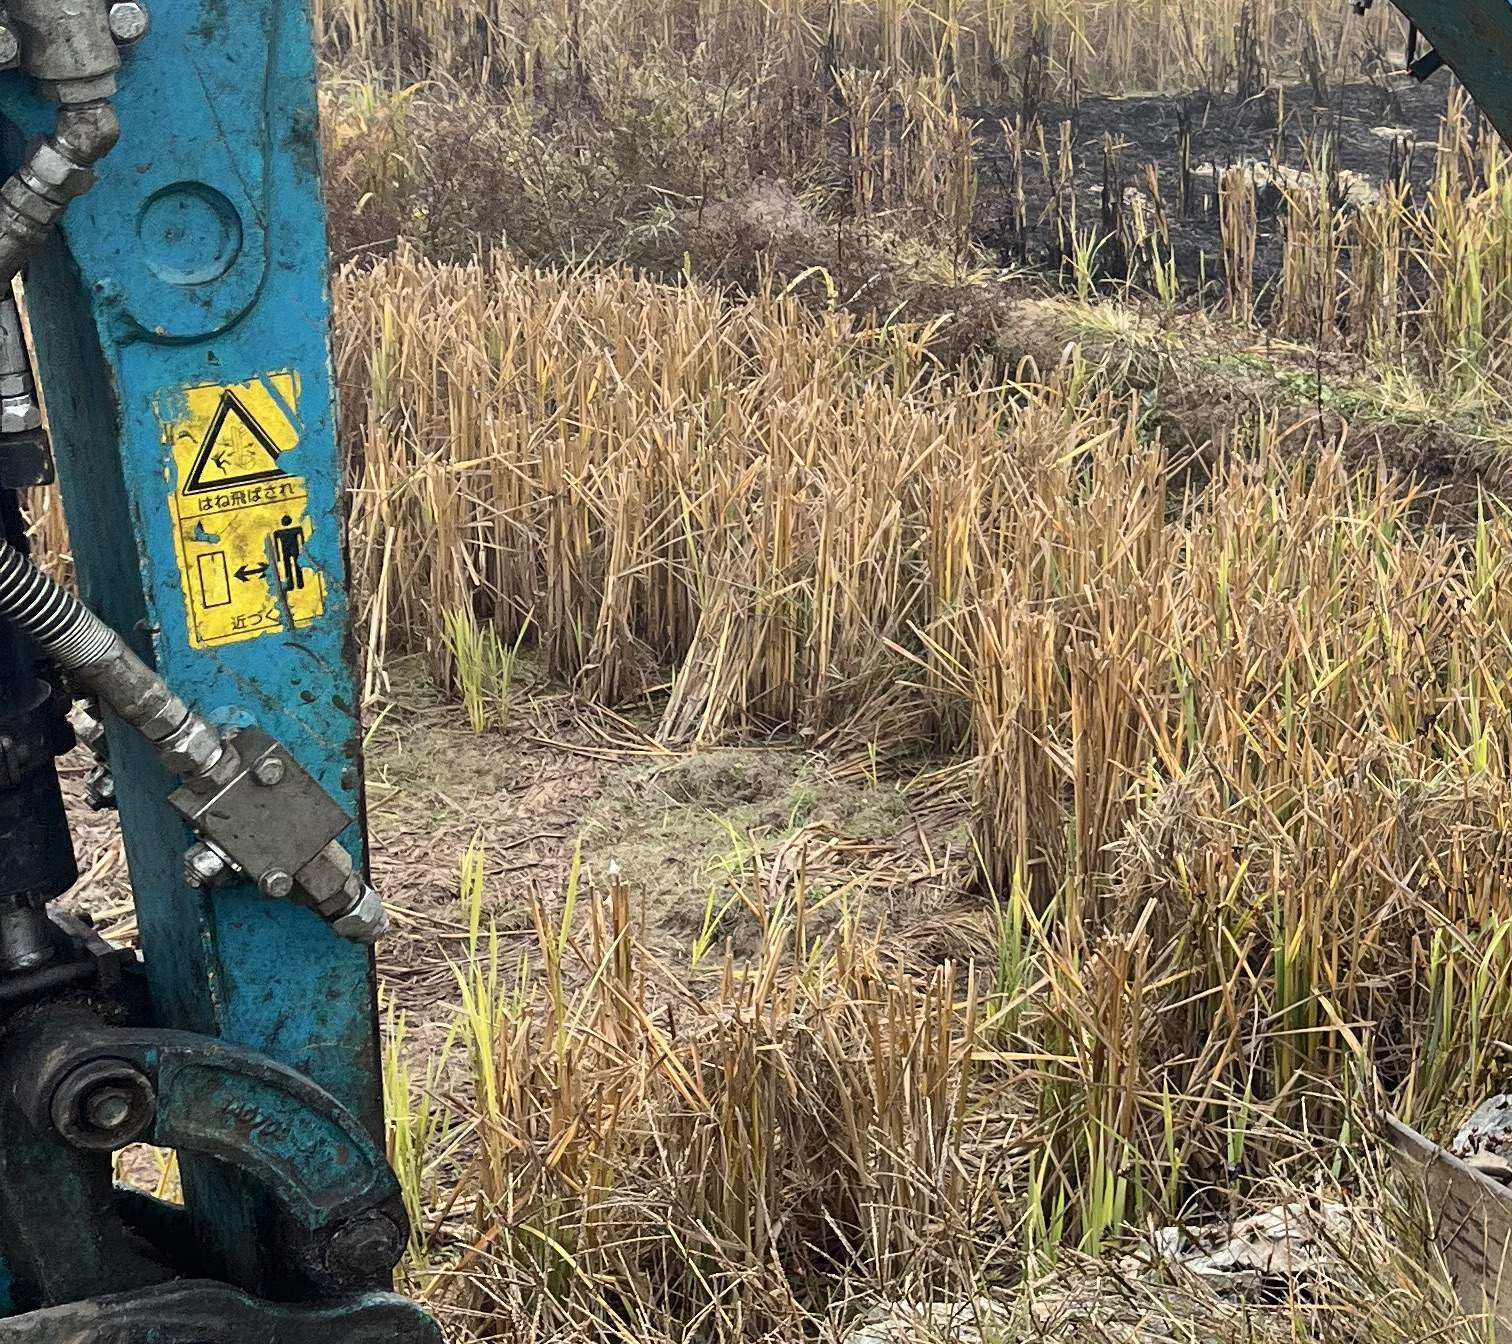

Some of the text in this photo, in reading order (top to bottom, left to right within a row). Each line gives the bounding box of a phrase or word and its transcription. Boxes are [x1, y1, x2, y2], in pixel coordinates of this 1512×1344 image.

[198, 482, 295, 511] はね飛ばされ
[231, 608, 279, 630] 近づく
